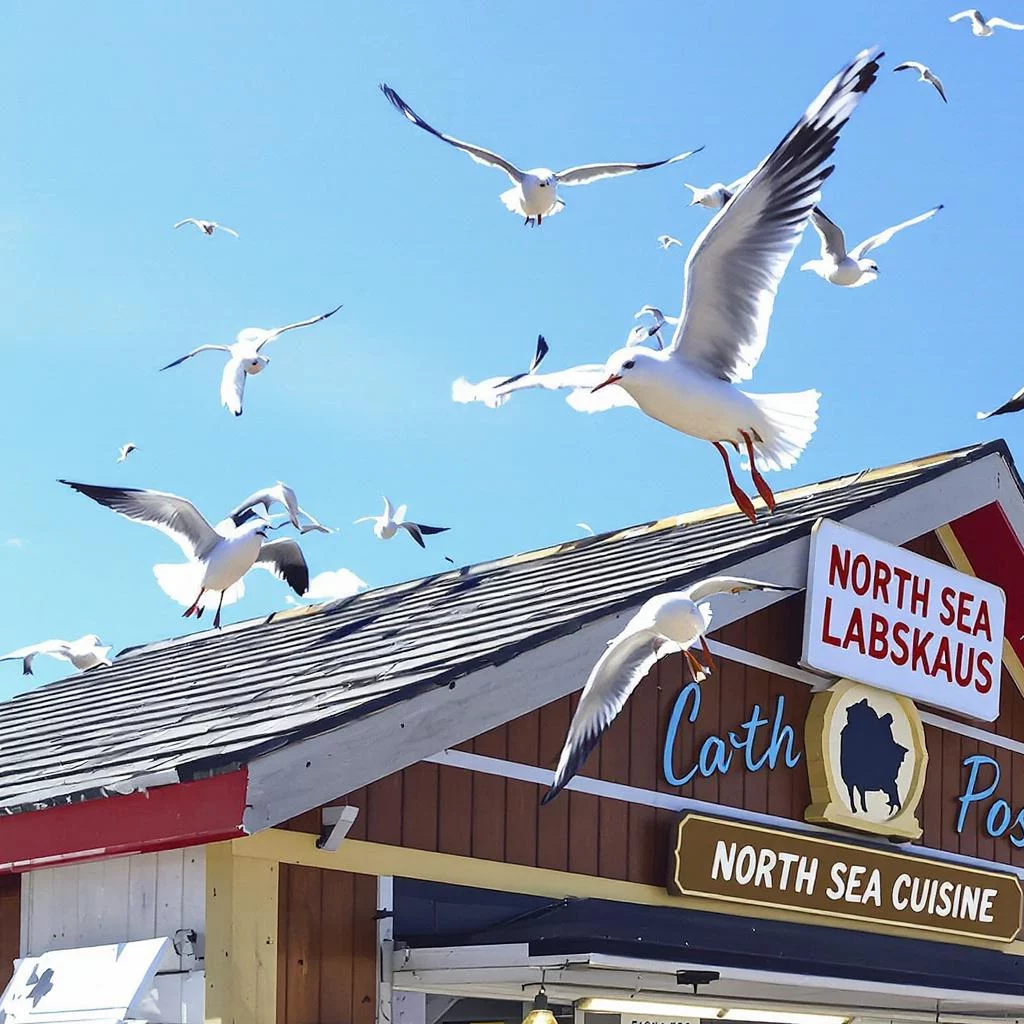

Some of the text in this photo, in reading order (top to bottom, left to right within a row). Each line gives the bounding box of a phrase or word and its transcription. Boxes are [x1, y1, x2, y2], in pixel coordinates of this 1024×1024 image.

[829, 544, 992, 642] NORTH SEA
[821, 597, 995, 694] LABSKAUS
[710, 840, 998, 923] NORTH SEA CUISINE
